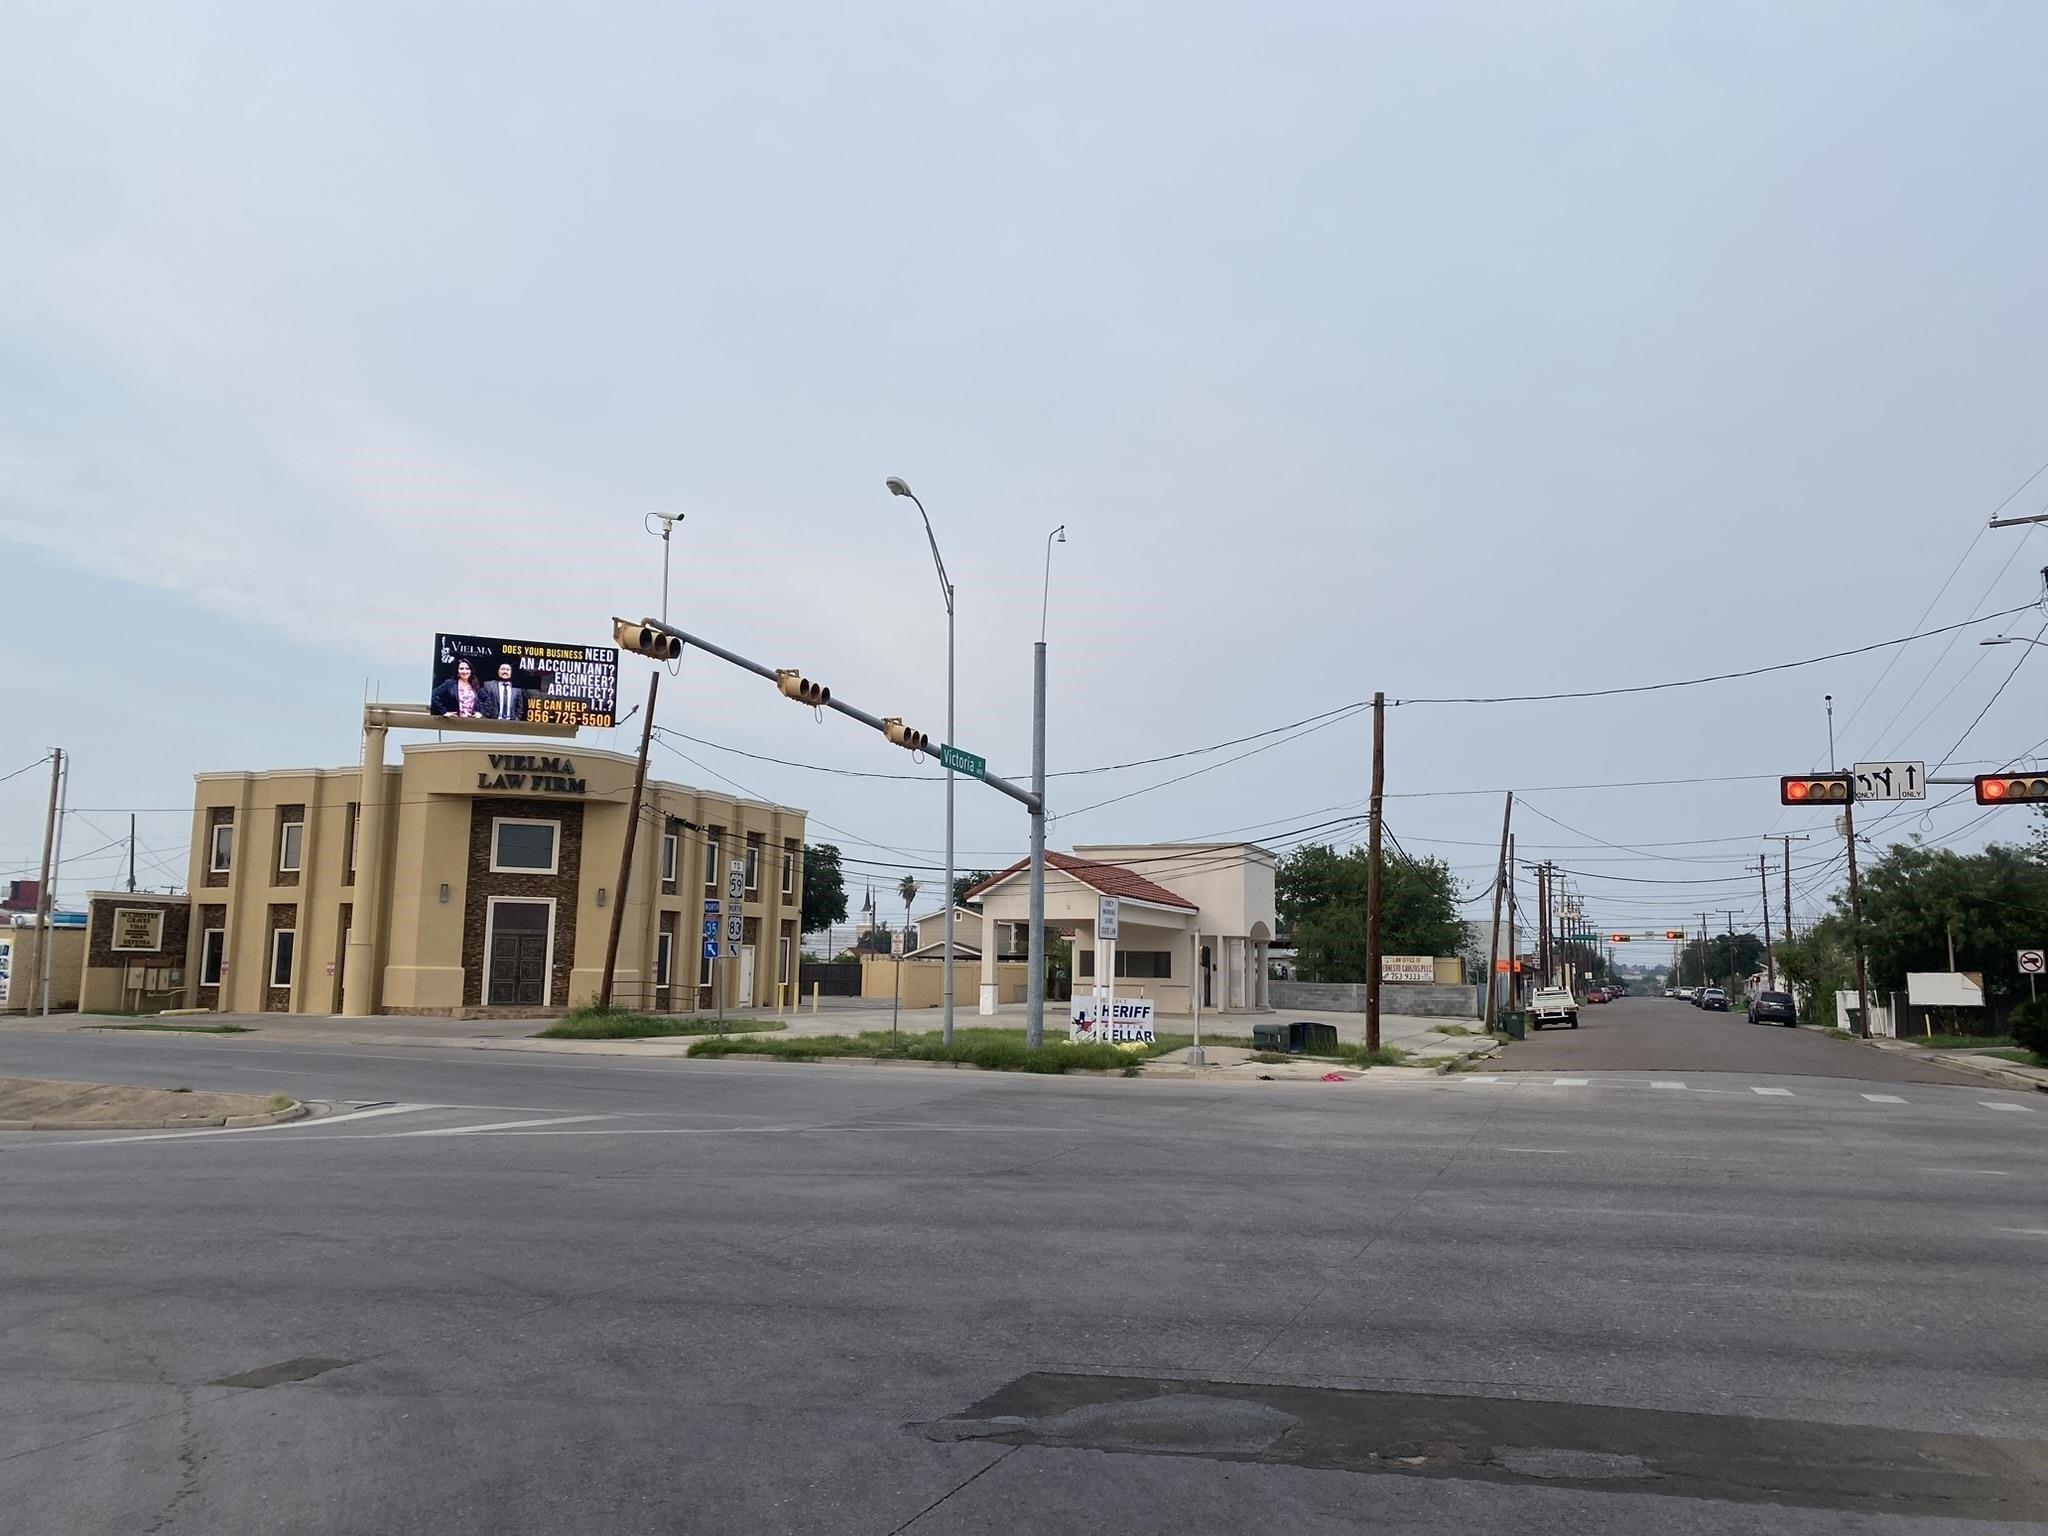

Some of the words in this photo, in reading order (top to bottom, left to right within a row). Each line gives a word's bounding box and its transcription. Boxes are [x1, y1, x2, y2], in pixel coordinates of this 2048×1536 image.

[451, 641, 493, 655] VIELMA
[502, 644, 522, 655] DOES
[524, 646, 544, 657] YOUR
[546, 648, 583, 660] BUSINESS
[585, 648, 614, 662] NEED
[520, 657, 535, 670] AN
[537, 659, 615, 677] ACCOUNTANT?
[554, 672, 615, 688] ENGINEER?
[547, 683, 614, 700] ARCHITECT?
[527, 698, 541, 709] WE
[543, 699, 562, 711] CAN
[564, 701, 587, 712] HELP
[590, 698, 614, 712] I.T.?
[527, 709, 611, 727] 956-725-5500
[488, 754, 575, 774] VIELMA
[943, 748, 975, 772] Victoria
[477, 773, 526, 789] LAW
[530, 775, 588, 793] FIRM
[733, 862, 740, 870] TO
[731, 879, 742, 892] 59
[705, 903, 720, 911] NORTH
[706, 923, 717, 935] 35
[730, 921, 741, 935] 83
[1383, 964, 1401, 972] ERNESTO
